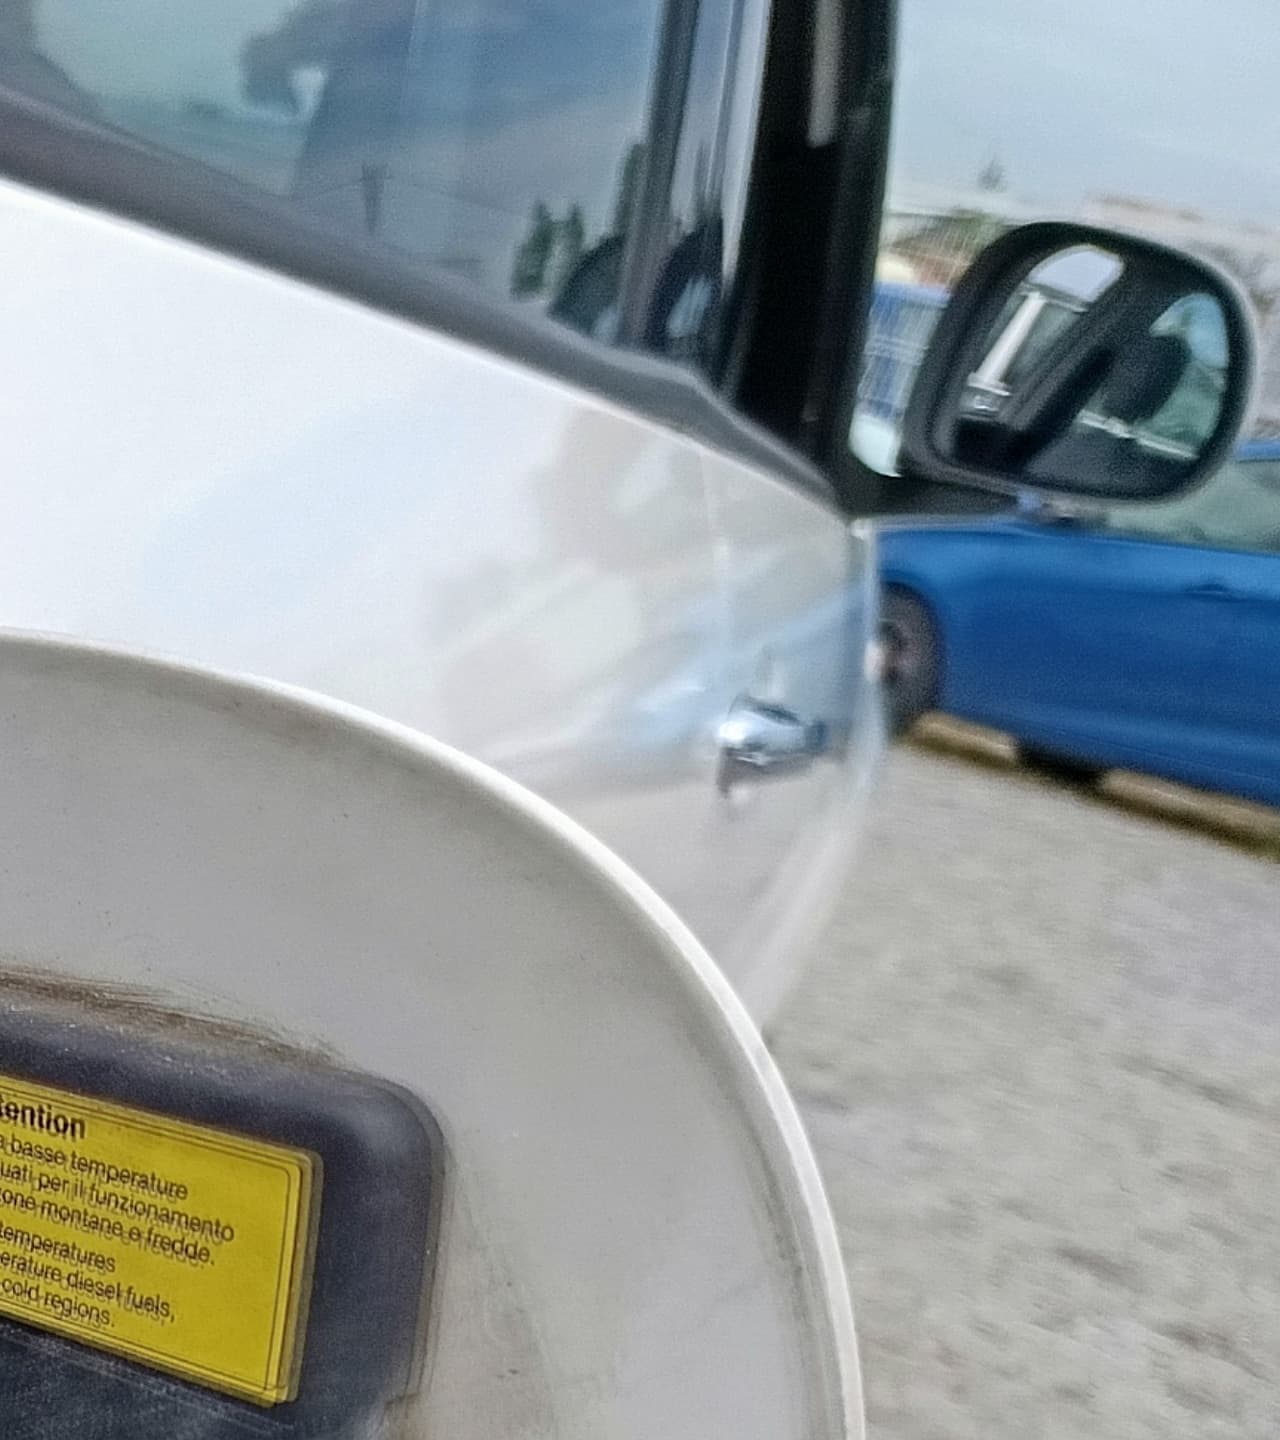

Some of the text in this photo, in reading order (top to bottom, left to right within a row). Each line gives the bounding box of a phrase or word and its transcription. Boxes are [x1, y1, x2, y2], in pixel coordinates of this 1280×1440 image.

[9, 1132, 66, 1166] basse
[69, 1148, 189, 1200] temperature
[36, 1173, 69, 1196] per
[73, 1178, 85, 1200] il
[87, 1182, 236, 1244] funzionamento
[39, 1202, 123, 1240] montane
[126, 1227, 141, 1246] e
[145, 1227, 215, 1265] fredde.
[0, 1278, 41, 1304] cold
[43, 1292, 115, 1329] regions.
[65, 1267, 122, 1304] diesel
[123, 1286, 175, 1327] fuels,
